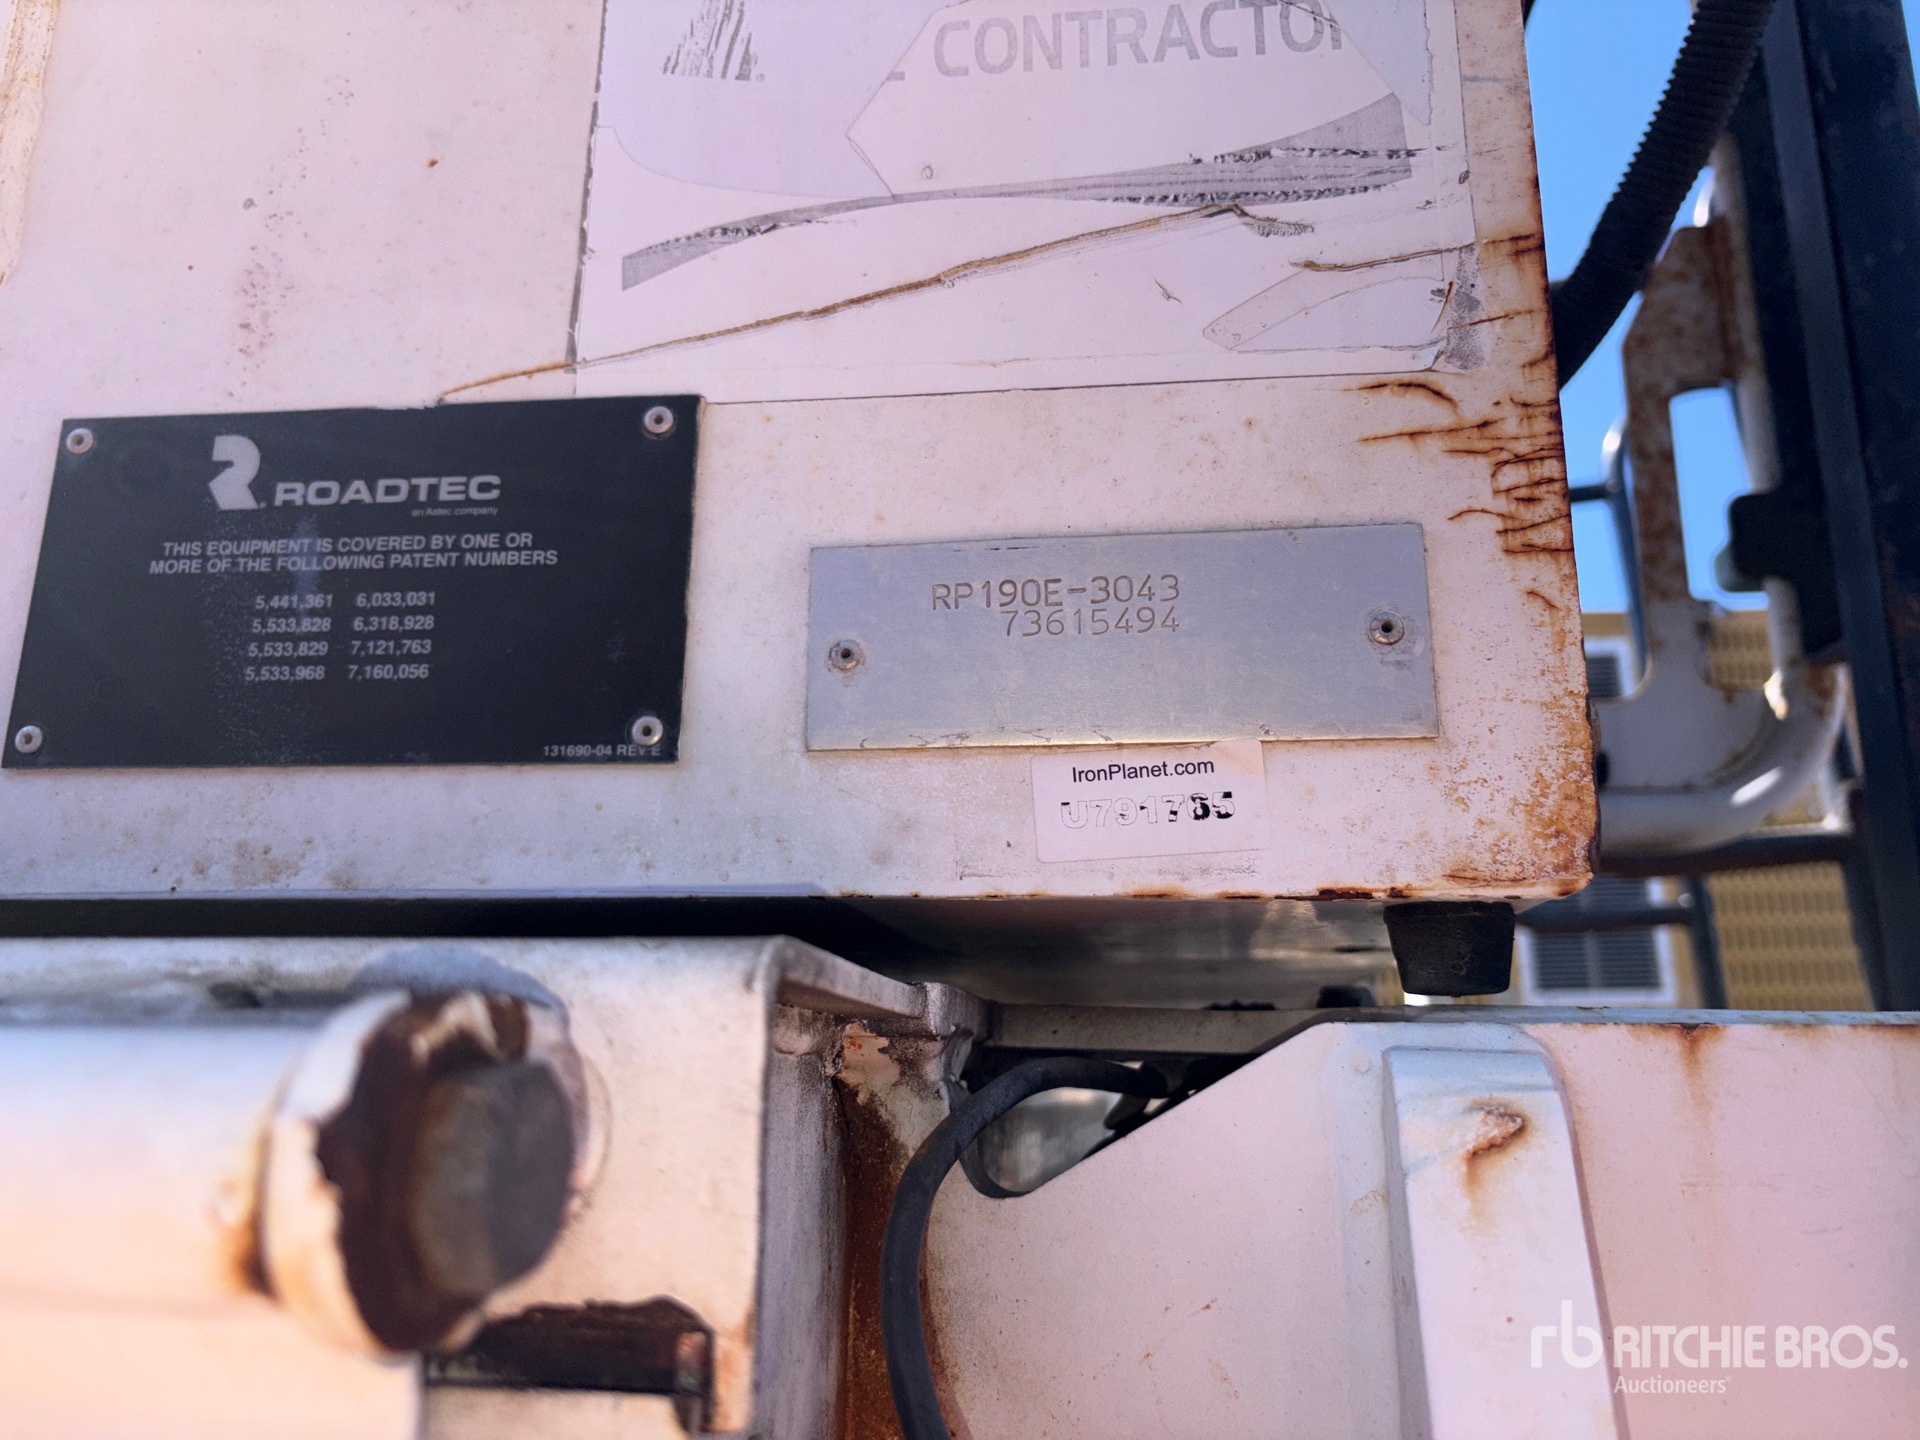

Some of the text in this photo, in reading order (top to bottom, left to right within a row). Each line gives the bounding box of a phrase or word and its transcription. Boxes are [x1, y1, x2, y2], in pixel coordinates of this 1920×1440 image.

[274, 475, 501, 506] ROADTEC
[454, 506, 499, 516] company
[163, 532, 533, 557] THIS EQUIPMENT IS COVERED BY ONE OR
[149, 550, 558, 575] MORE OF THE FOLLOWING PATENT NUMBERS
[254, 591, 436, 611] 5,441,361 6,033,031
[931, 573, 1181, 610] RP190E-3043
[251, 615, 435, 635] 5,533,828 6,318,928
[1000, 606, 1181, 637] 73615494
[248, 639, 432, 659] 5,533,829 7,121,763
[244, 664, 430, 683] 5,533,968 7,160,056
[543, 744, 613, 757] 131690-04
[1071, 760, 1216, 783] IronPlanet.com
